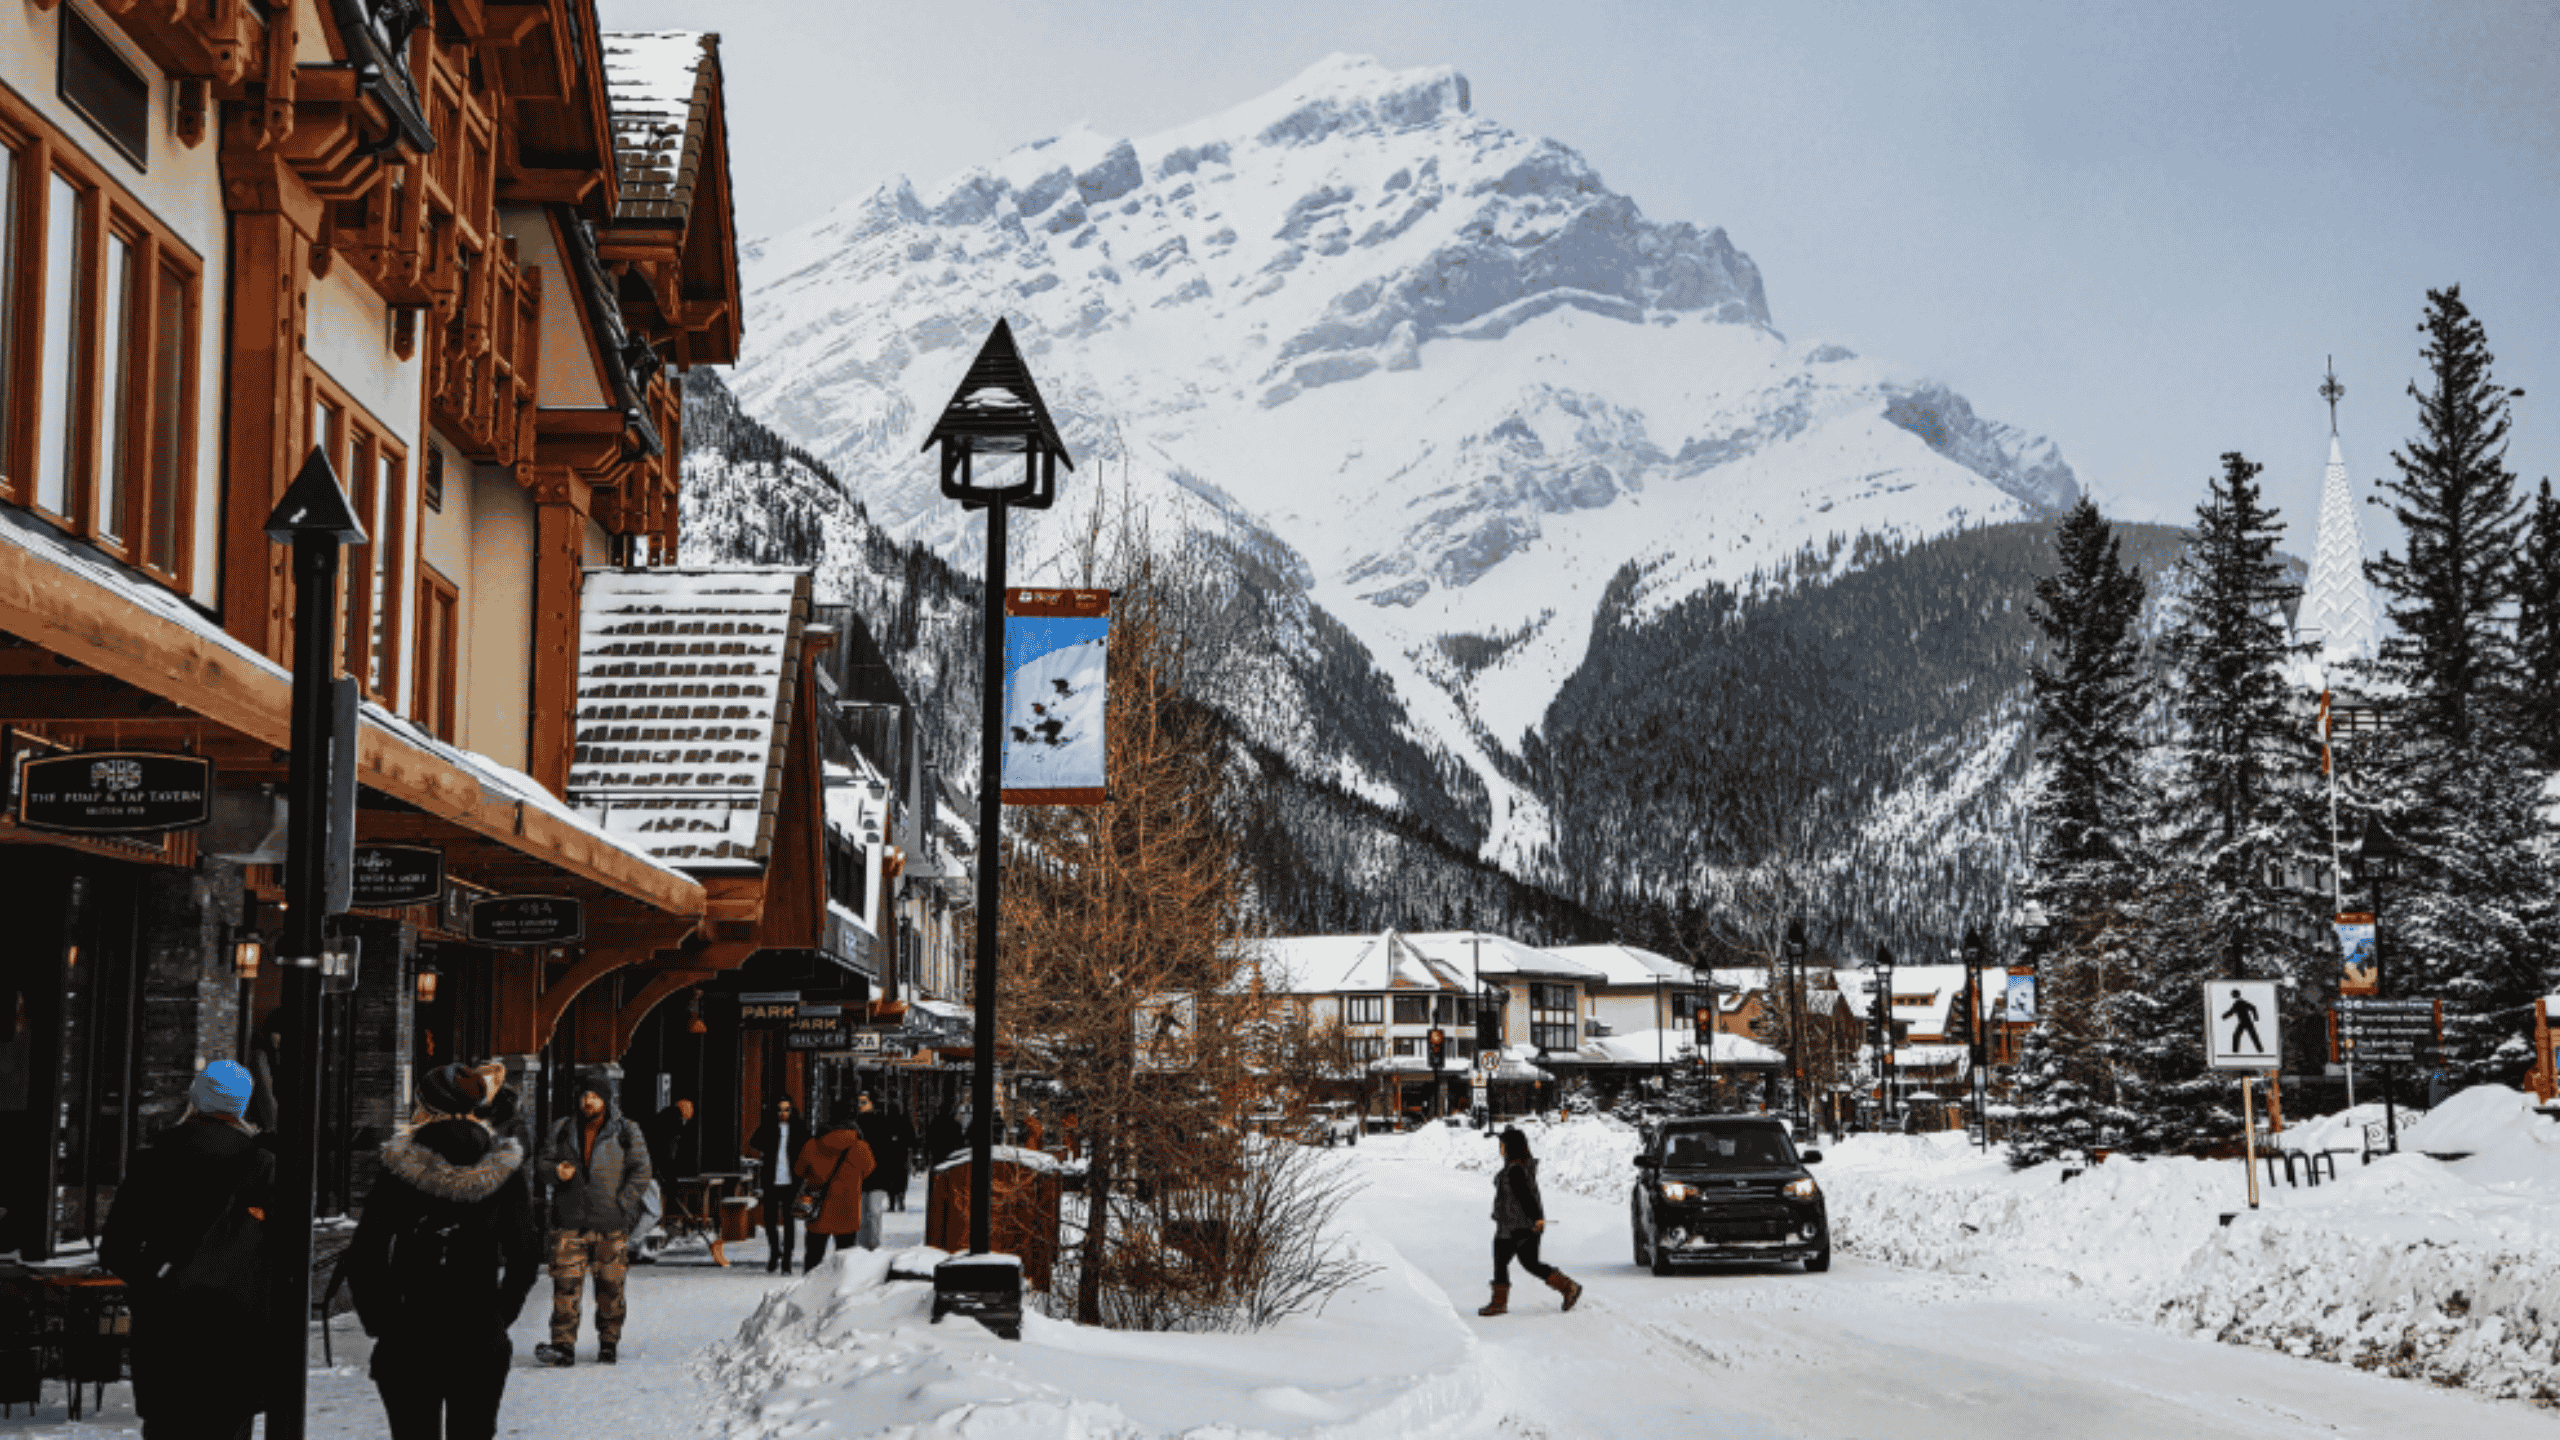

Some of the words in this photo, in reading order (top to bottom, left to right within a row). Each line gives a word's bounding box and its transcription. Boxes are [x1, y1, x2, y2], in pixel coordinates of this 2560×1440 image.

[31, 792, 56, 803] THE
[64, 791, 101, 802] PUMP
[121, 791, 145, 802] TAP
[149, 790, 201, 802] TAVERN
[742, 1005, 795, 1018] PARK
